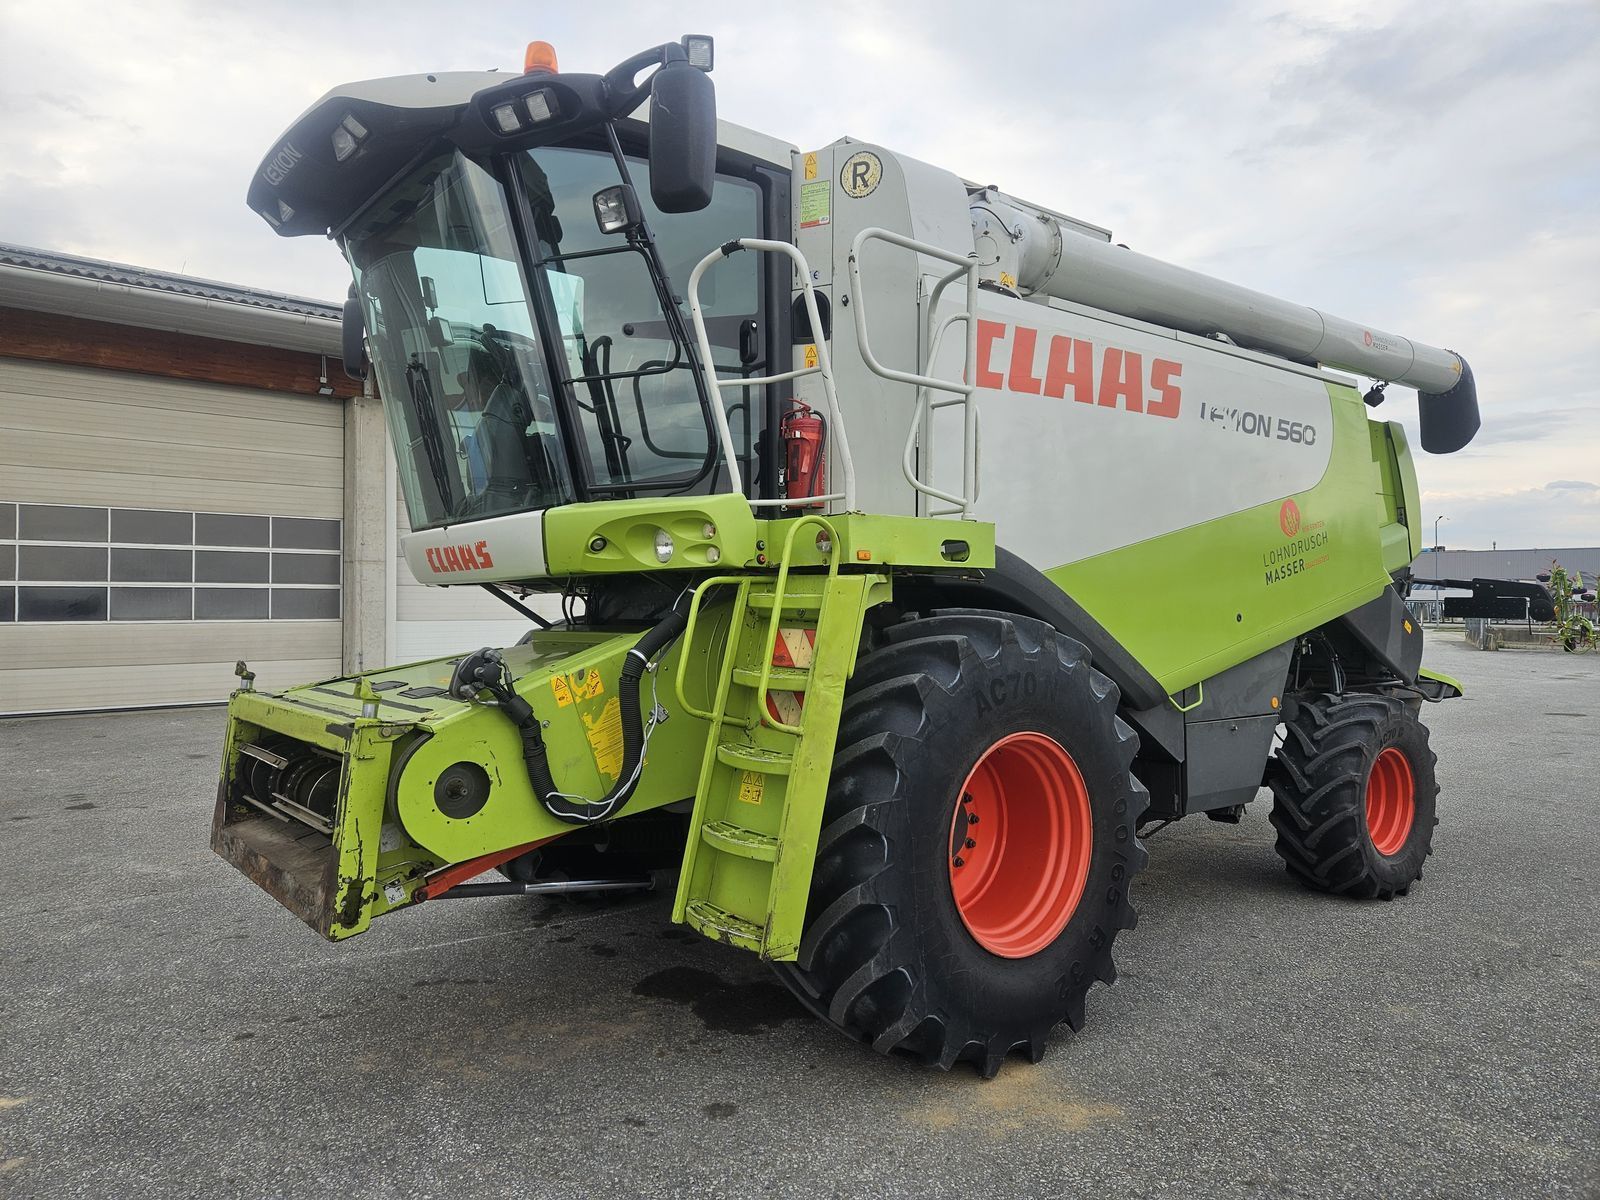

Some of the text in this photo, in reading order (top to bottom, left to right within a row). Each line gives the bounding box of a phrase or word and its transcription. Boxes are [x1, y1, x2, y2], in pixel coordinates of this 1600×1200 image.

[262, 142, 302, 186] LEXION
[852, 160, 870, 190] R
[963, 318, 1183, 419] CLAAS
[1277, 418, 1316, 446] 560
[425, 540, 494, 574] CLAAS
[1263, 531, 1329, 567] LOHNDRUSCH
[1265, 558, 1305, 586] MASSER
[974, 671, 1037, 719] AC70
